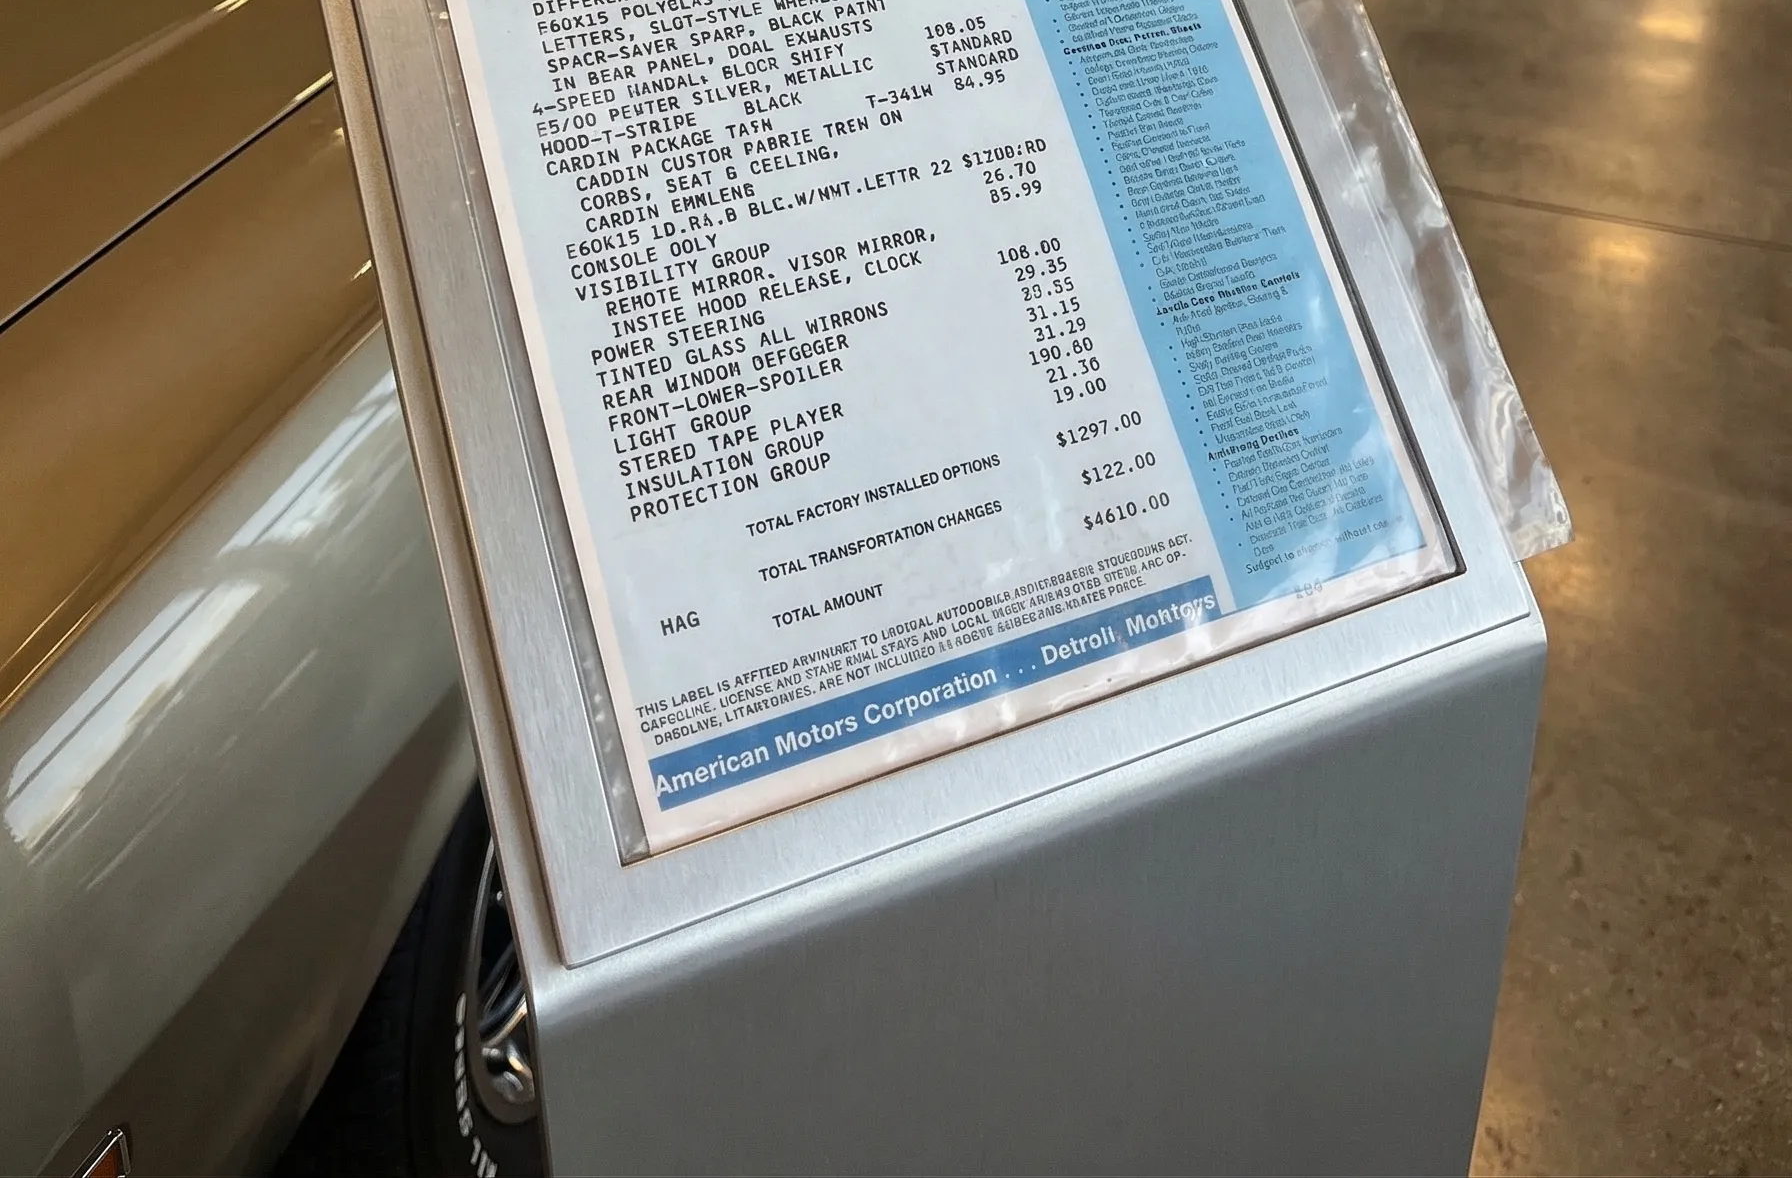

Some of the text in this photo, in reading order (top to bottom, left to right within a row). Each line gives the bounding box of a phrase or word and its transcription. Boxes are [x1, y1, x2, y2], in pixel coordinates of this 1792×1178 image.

[767, 9, 825, 32] BLACK
[541, 26, 635, 55] LETTERS,
[551, 75, 577, 93] IN
[587, 64, 637, 86] BEAR
[727, 39, 775, 60] DOAL
[783, 56, 874, 87] METALLIC
[953, 68, 1006, 91] 84.95
[532, 88, 616, 116] 4-SPEED
[743, 91, 803, 116] BLACK
[546, 128, 715, 177] CARDIN PACKAGE
[930, 158, 953, 177] 22
[665, 170, 712, 194] SEAT
[982, 160, 1037, 185] 26.70
[585, 203, 660, 234] CARDIN
[574, 242, 771, 302] VISIBILITY GROUP
[787, 245, 848, 273] VISOR
[1014, 255, 1068, 283] 29.35
[696, 292, 747, 318] HOOD
[864, 249, 923, 277] CLOCK
[590, 309, 766, 366] POWER STEERING
[595, 355, 673, 388] TINTED
[685, 336, 747, 365] GLASS
[760, 326, 796, 348] ALL
[601, 383, 655, 411] REAR
[607, 357, 844, 433] FRONT-LOWER-SPOILER
[613, 404, 752, 455] LIGHT GROUP
[706, 424, 760, 452] TAPE
[769, 402, 845, 436] PLAYER
[1055, 410, 1142, 448] $1297.00
[764, 430, 825, 460] GROUP
[1081, 451, 1156, 486] $122.00
[629, 452, 831, 523] PROTECTION GROUP
[745, 453, 1001, 537] TOTAL FACTORY INSTALLED OPTIONS
[757, 558, 808, 582] TOTAL
[771, 583, 883, 628] TOTAL AMOUNT
[659, 610, 701, 637] HAG
[635, 699, 669, 718] THIS
[671, 685, 715, 708] LABEL
[716, 679, 731, 693] IS
[860, 633, 878, 646] TO
[650, 746, 770, 804] American
[774, 715, 858, 756] Motors
[864, 668, 998, 725] Corporation
